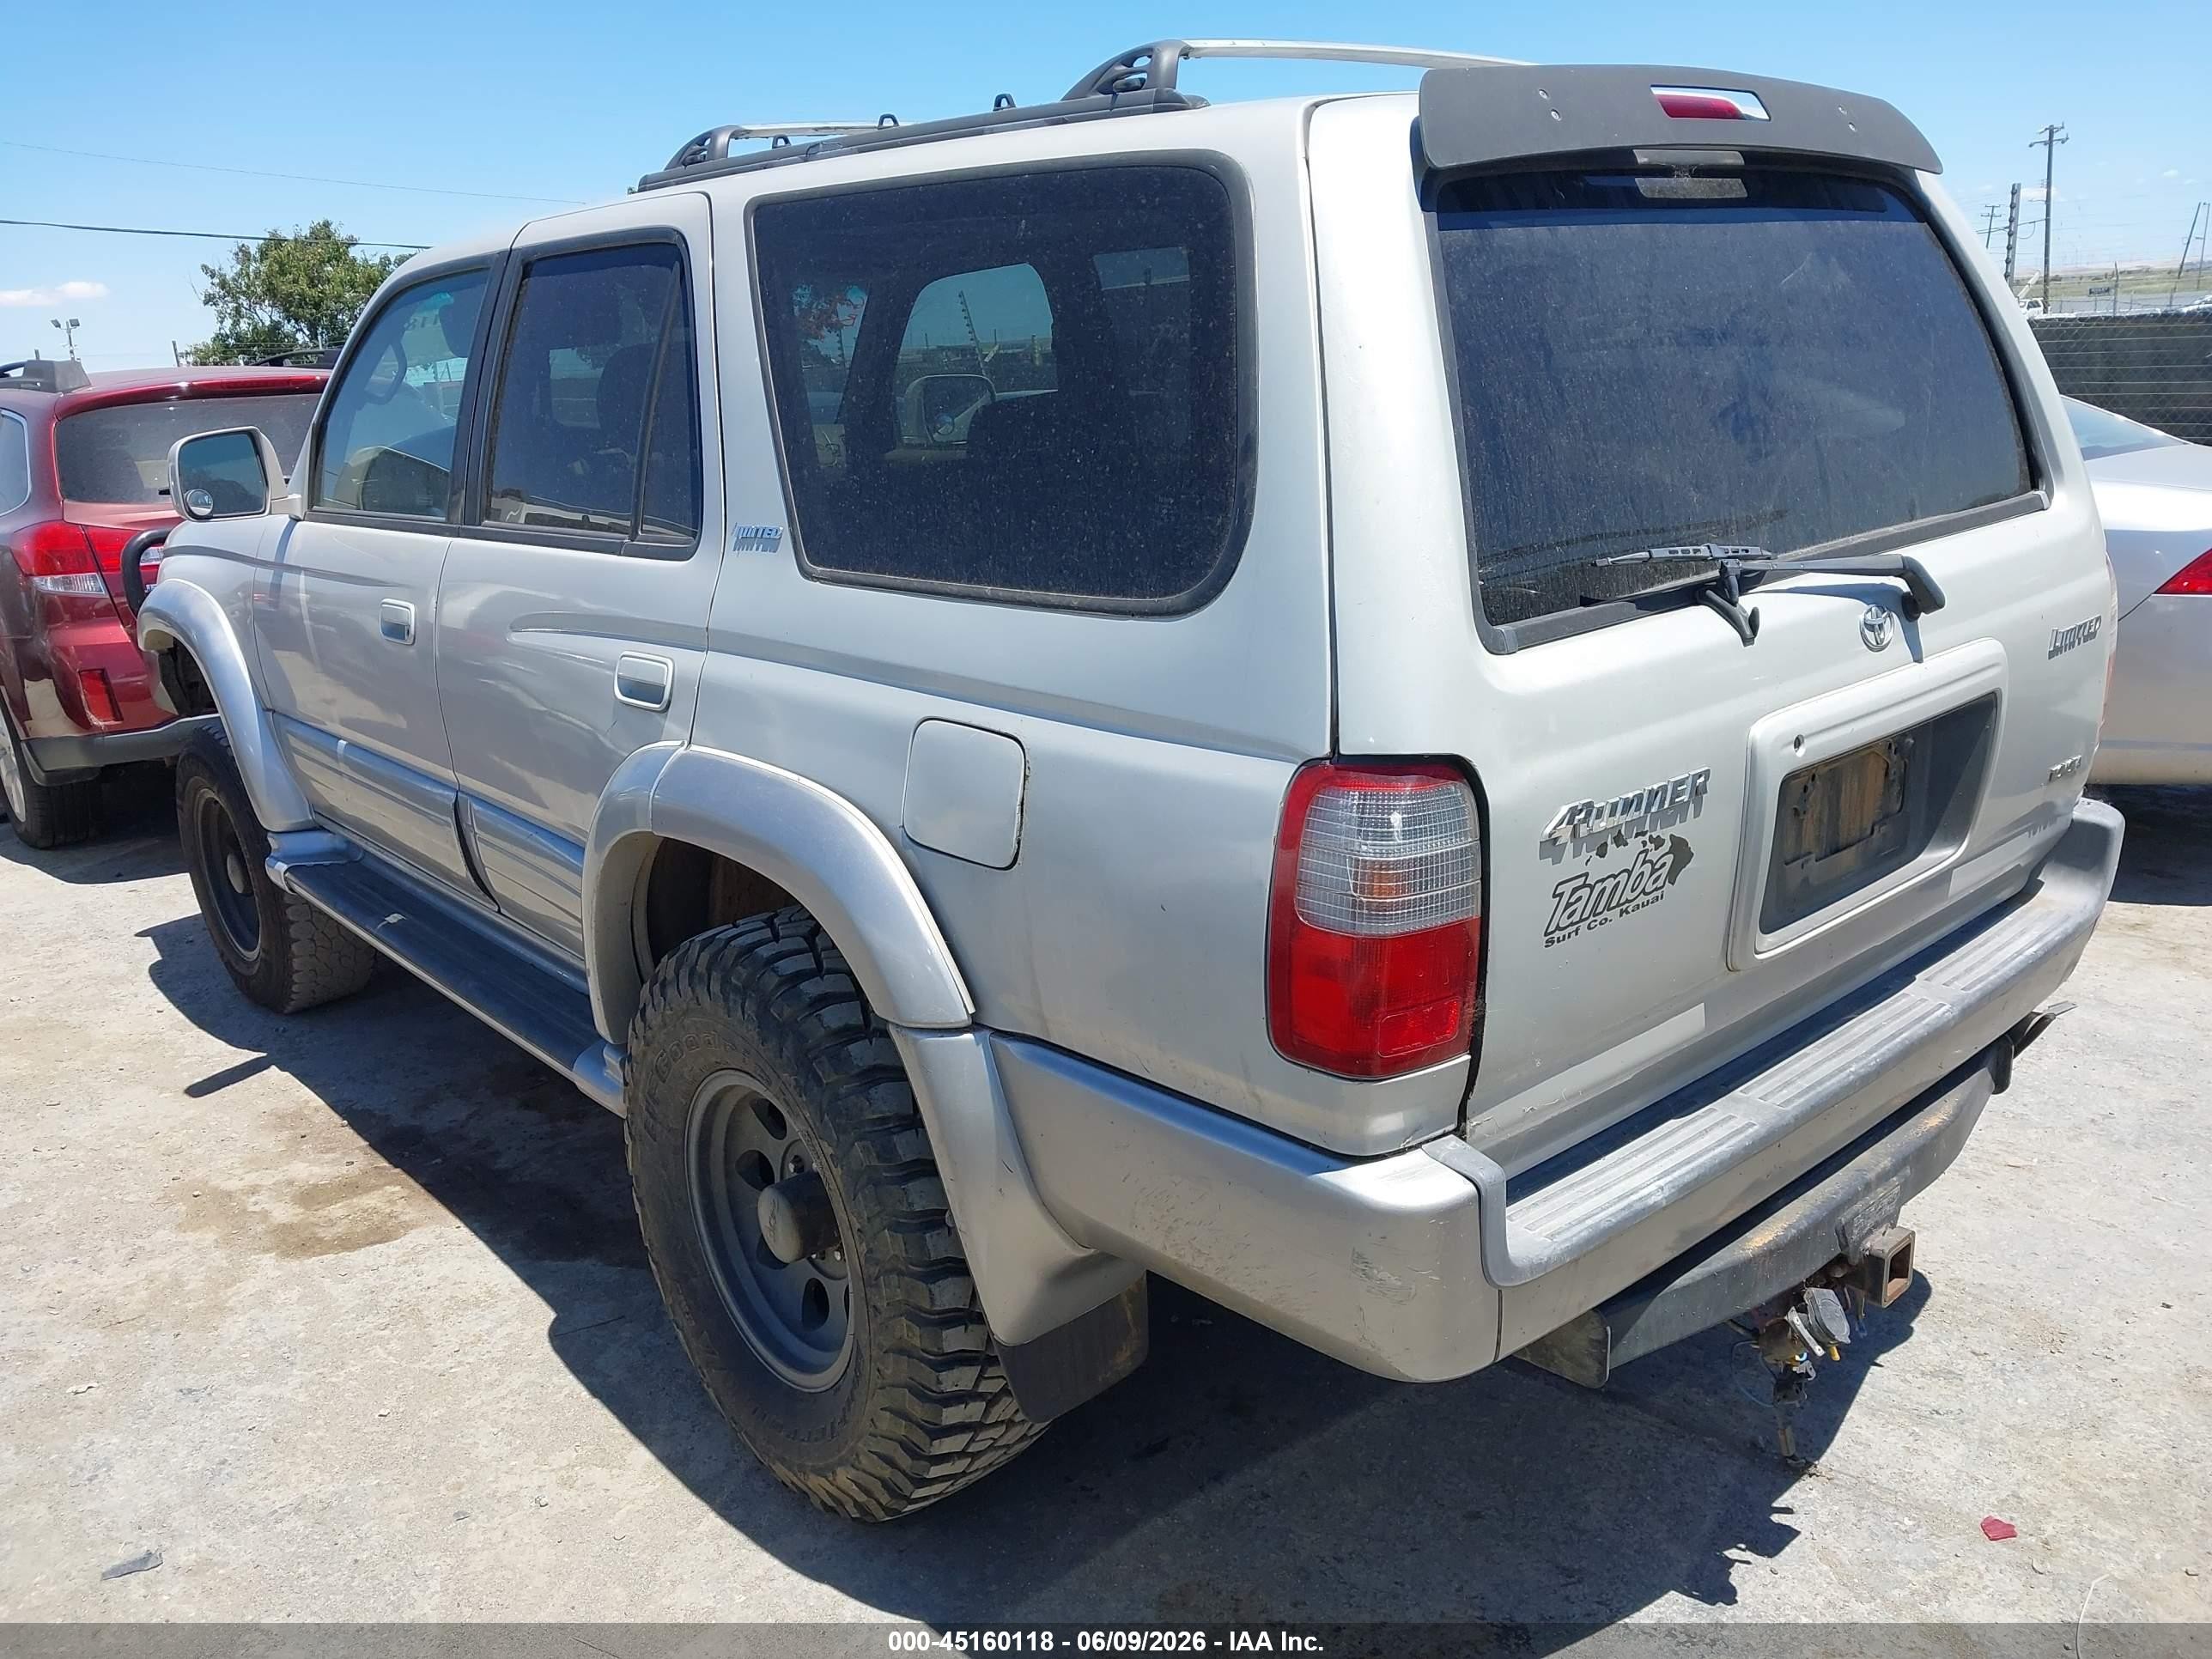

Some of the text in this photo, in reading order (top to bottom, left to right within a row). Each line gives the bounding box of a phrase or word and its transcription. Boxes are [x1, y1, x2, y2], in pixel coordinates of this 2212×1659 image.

[1544, 848, 1675, 937] Tamba
[1545, 890, 1664, 948] Surf Co. Kauai
